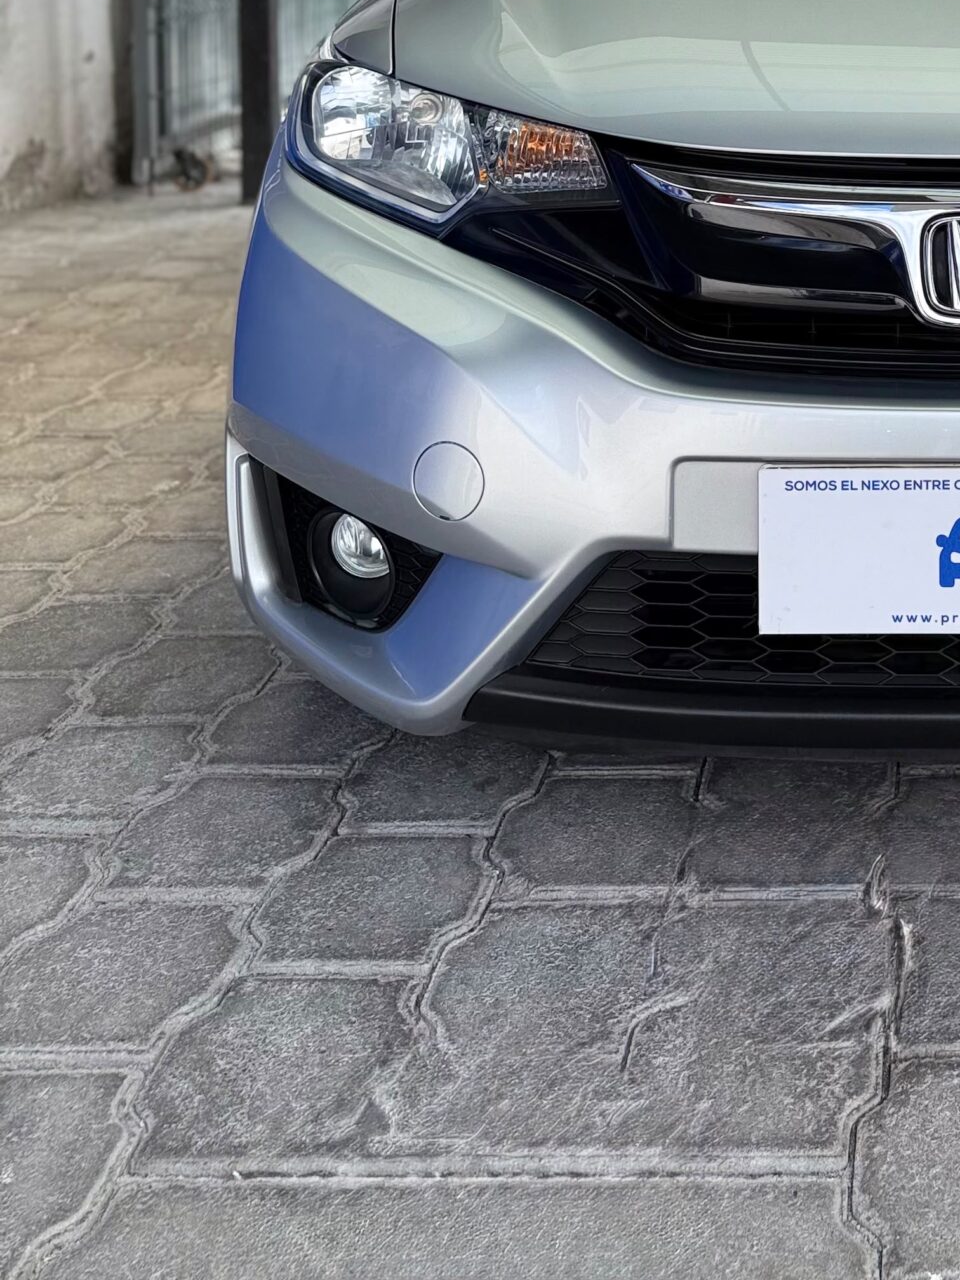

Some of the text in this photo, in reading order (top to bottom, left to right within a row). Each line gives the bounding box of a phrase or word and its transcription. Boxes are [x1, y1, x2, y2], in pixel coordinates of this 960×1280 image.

[784, 480, 837, 492] SOMOS
[840, 480, 858, 491] EL
[861, 480, 900, 491] NEXO
[904, 479, 950, 491] ENTRE
